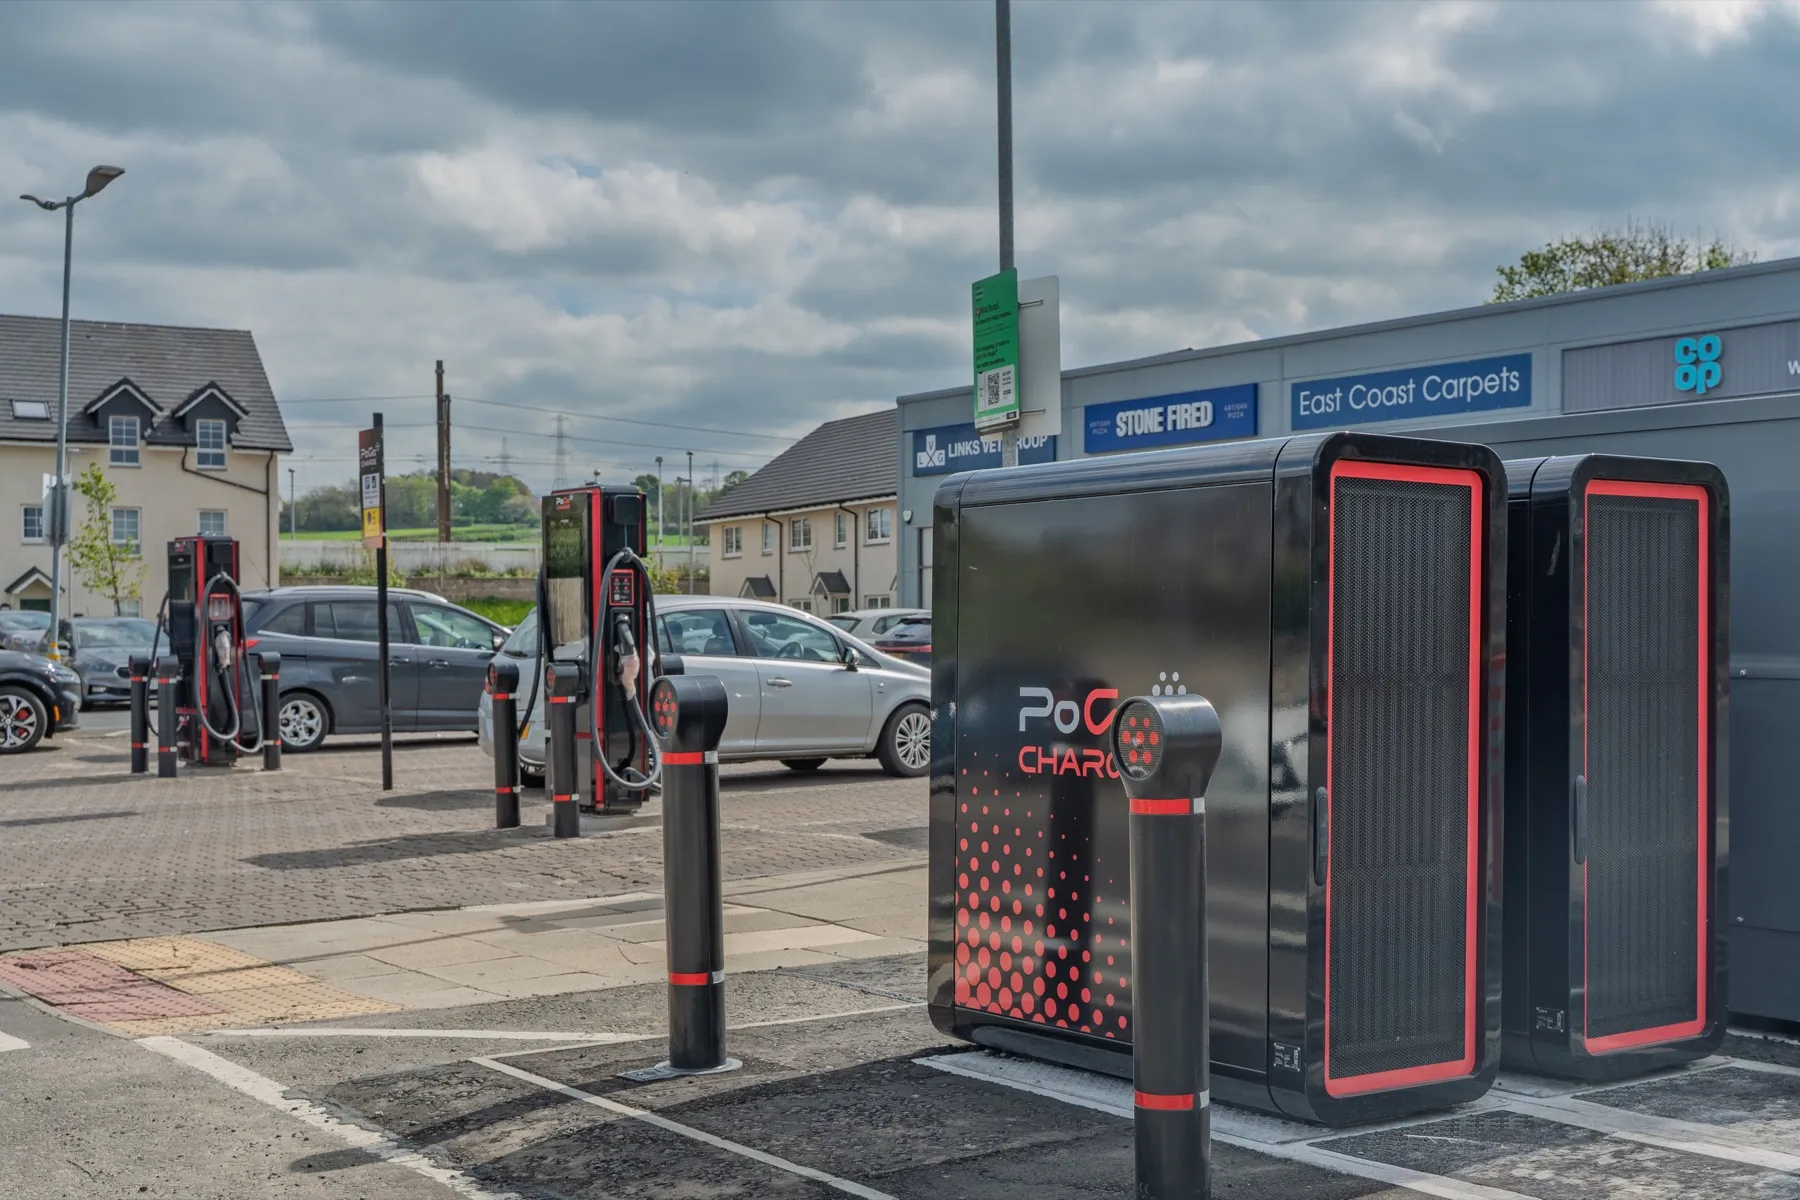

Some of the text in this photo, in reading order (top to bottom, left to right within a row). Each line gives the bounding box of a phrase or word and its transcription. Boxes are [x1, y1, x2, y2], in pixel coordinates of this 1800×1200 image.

[1300, 366, 1519, 415] East Coast Carpets
[1116, 401, 1213, 437] STONE FIRED
[948, 440, 980, 457] LINKS
[1019, 687, 1118, 735] PoG
